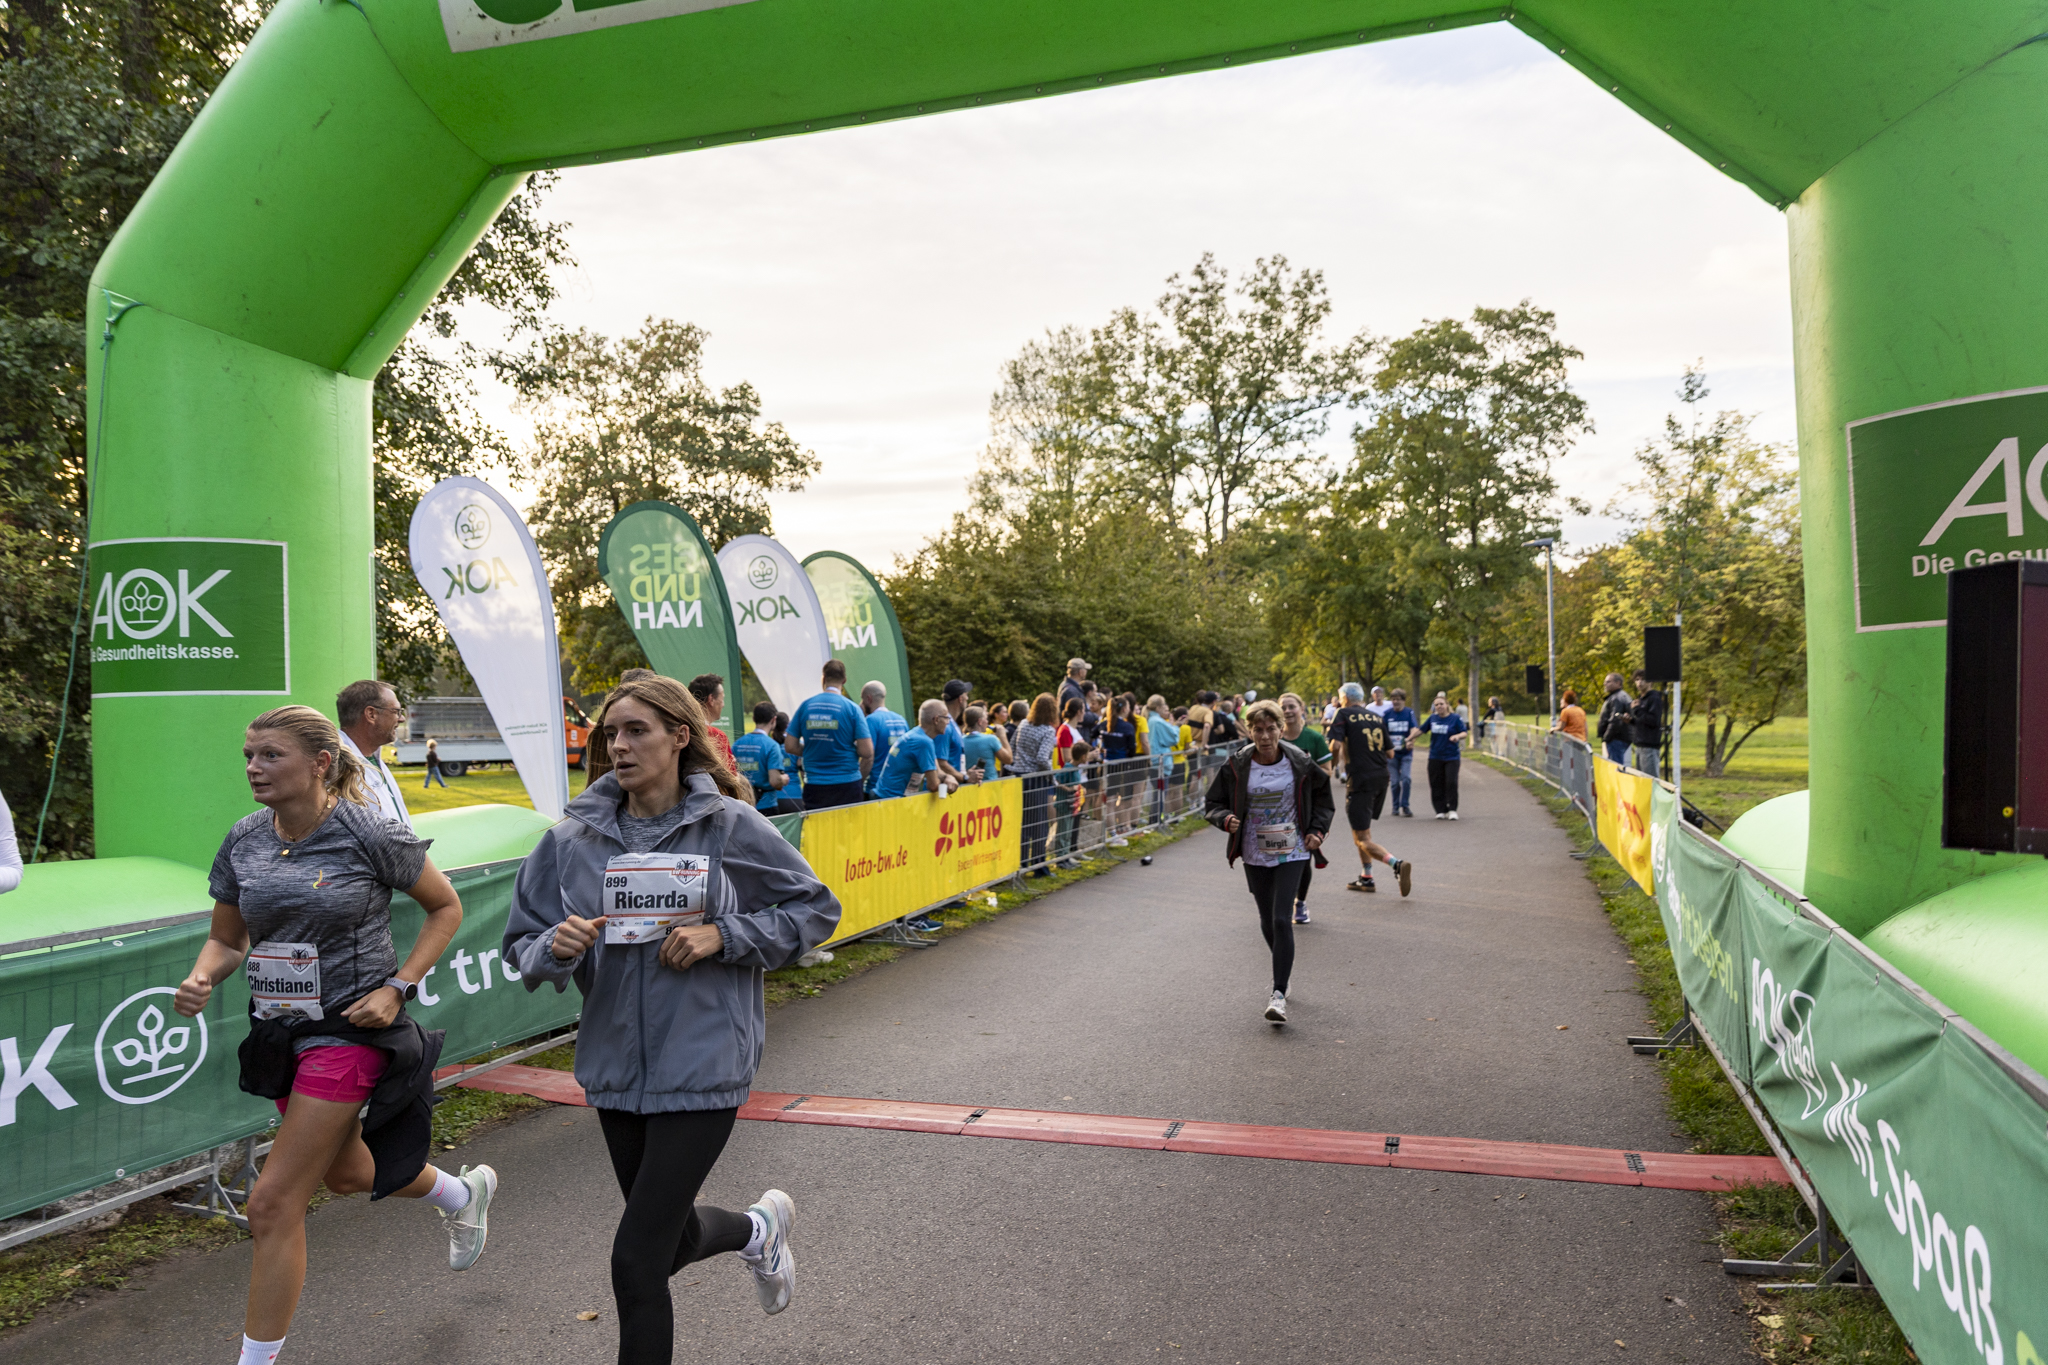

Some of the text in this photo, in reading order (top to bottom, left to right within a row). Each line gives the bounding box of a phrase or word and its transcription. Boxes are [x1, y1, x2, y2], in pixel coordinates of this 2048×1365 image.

[1912, 553, 1955, 577] Die
[91, 568, 234, 642] AOK
[97, 643, 239, 662] Gesundheitskasse.
[1361, 727, 1384, 752] 19
[958, 805, 1002, 848] LOTTO
[1266, 840, 1288, 849] Birgit
[845, 845, 908, 883] lotto-bw.de
[605, 876, 628, 888] 899
[615, 890, 688, 909] Ricarda
[247, 961, 260, 972] 888
[248, 975, 314, 993] Christiane
[1877, 1119, 2004, 1365] Spaß
